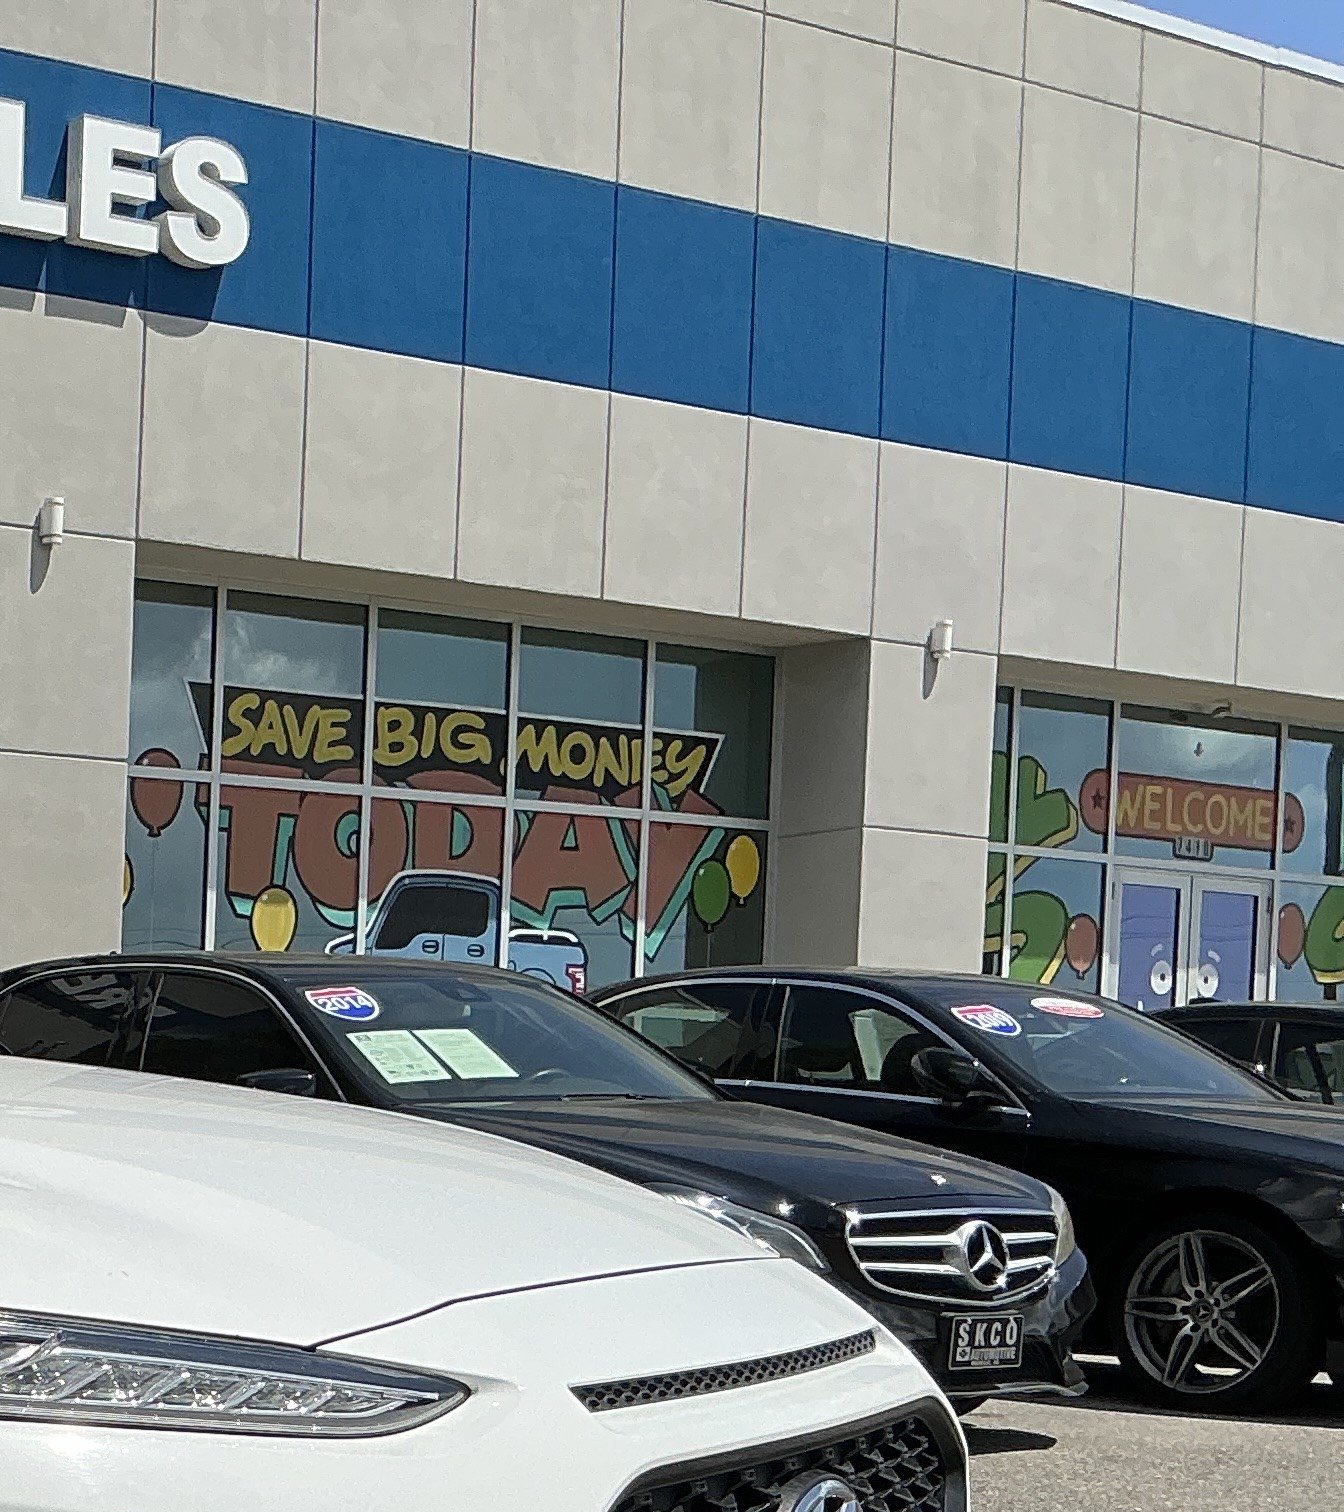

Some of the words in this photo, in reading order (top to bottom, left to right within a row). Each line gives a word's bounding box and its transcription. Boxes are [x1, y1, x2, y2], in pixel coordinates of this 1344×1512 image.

[220, 691, 354, 765] SAVE
[372, 705, 494, 767] BIG
[499, 722, 708, 799] MONEY
[1116, 784, 1273, 841] WELCOME
[198, 754, 724, 955] TODAY
[317, 995, 372, 1012] 2014
[957, 1321, 1018, 1347] SKCO
